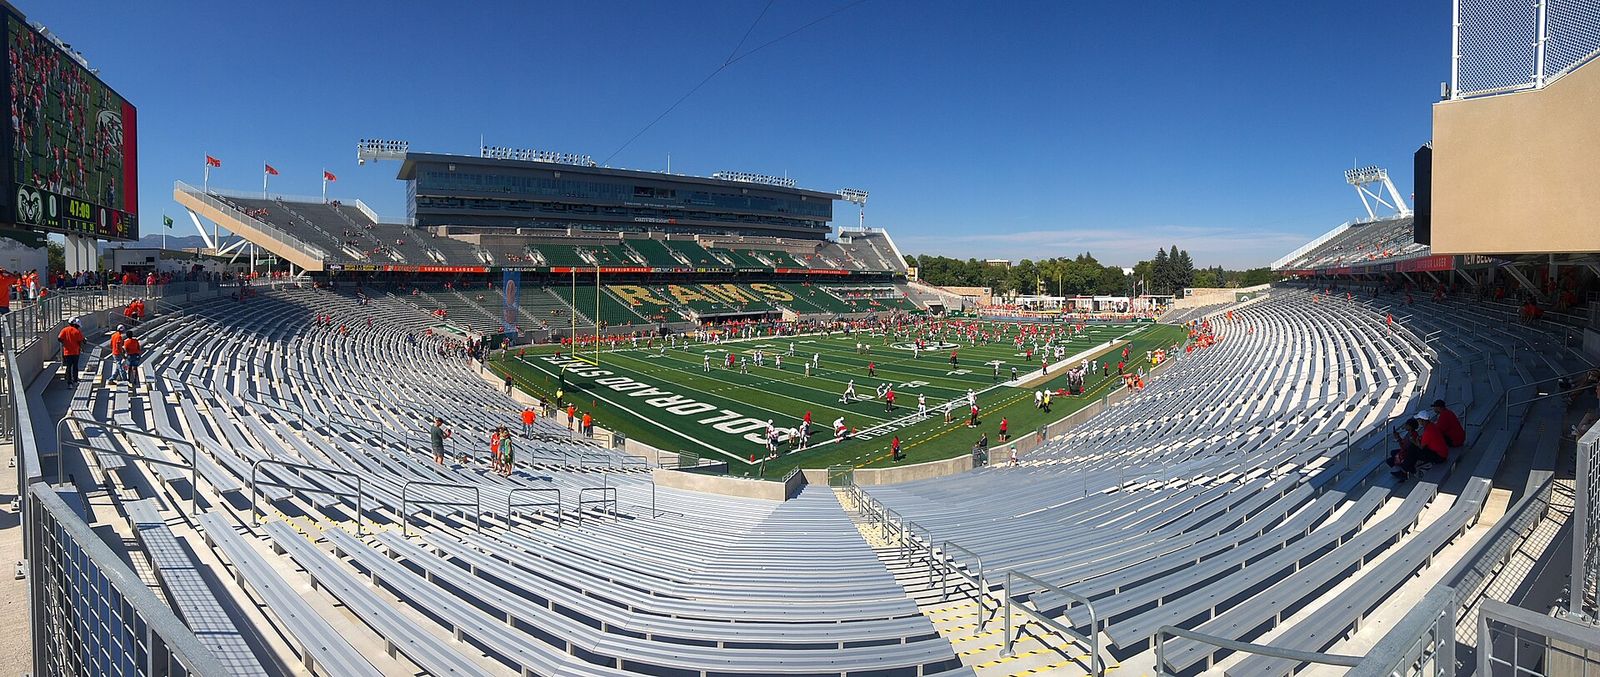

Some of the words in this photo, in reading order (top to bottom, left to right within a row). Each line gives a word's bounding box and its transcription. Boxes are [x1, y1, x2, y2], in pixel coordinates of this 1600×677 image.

[49, 195, 57, 217] 0
[101, 208, 107, 227] 0
[1463, 254, 1476, 266] NEW
[605, 283, 794, 306] RAMS
